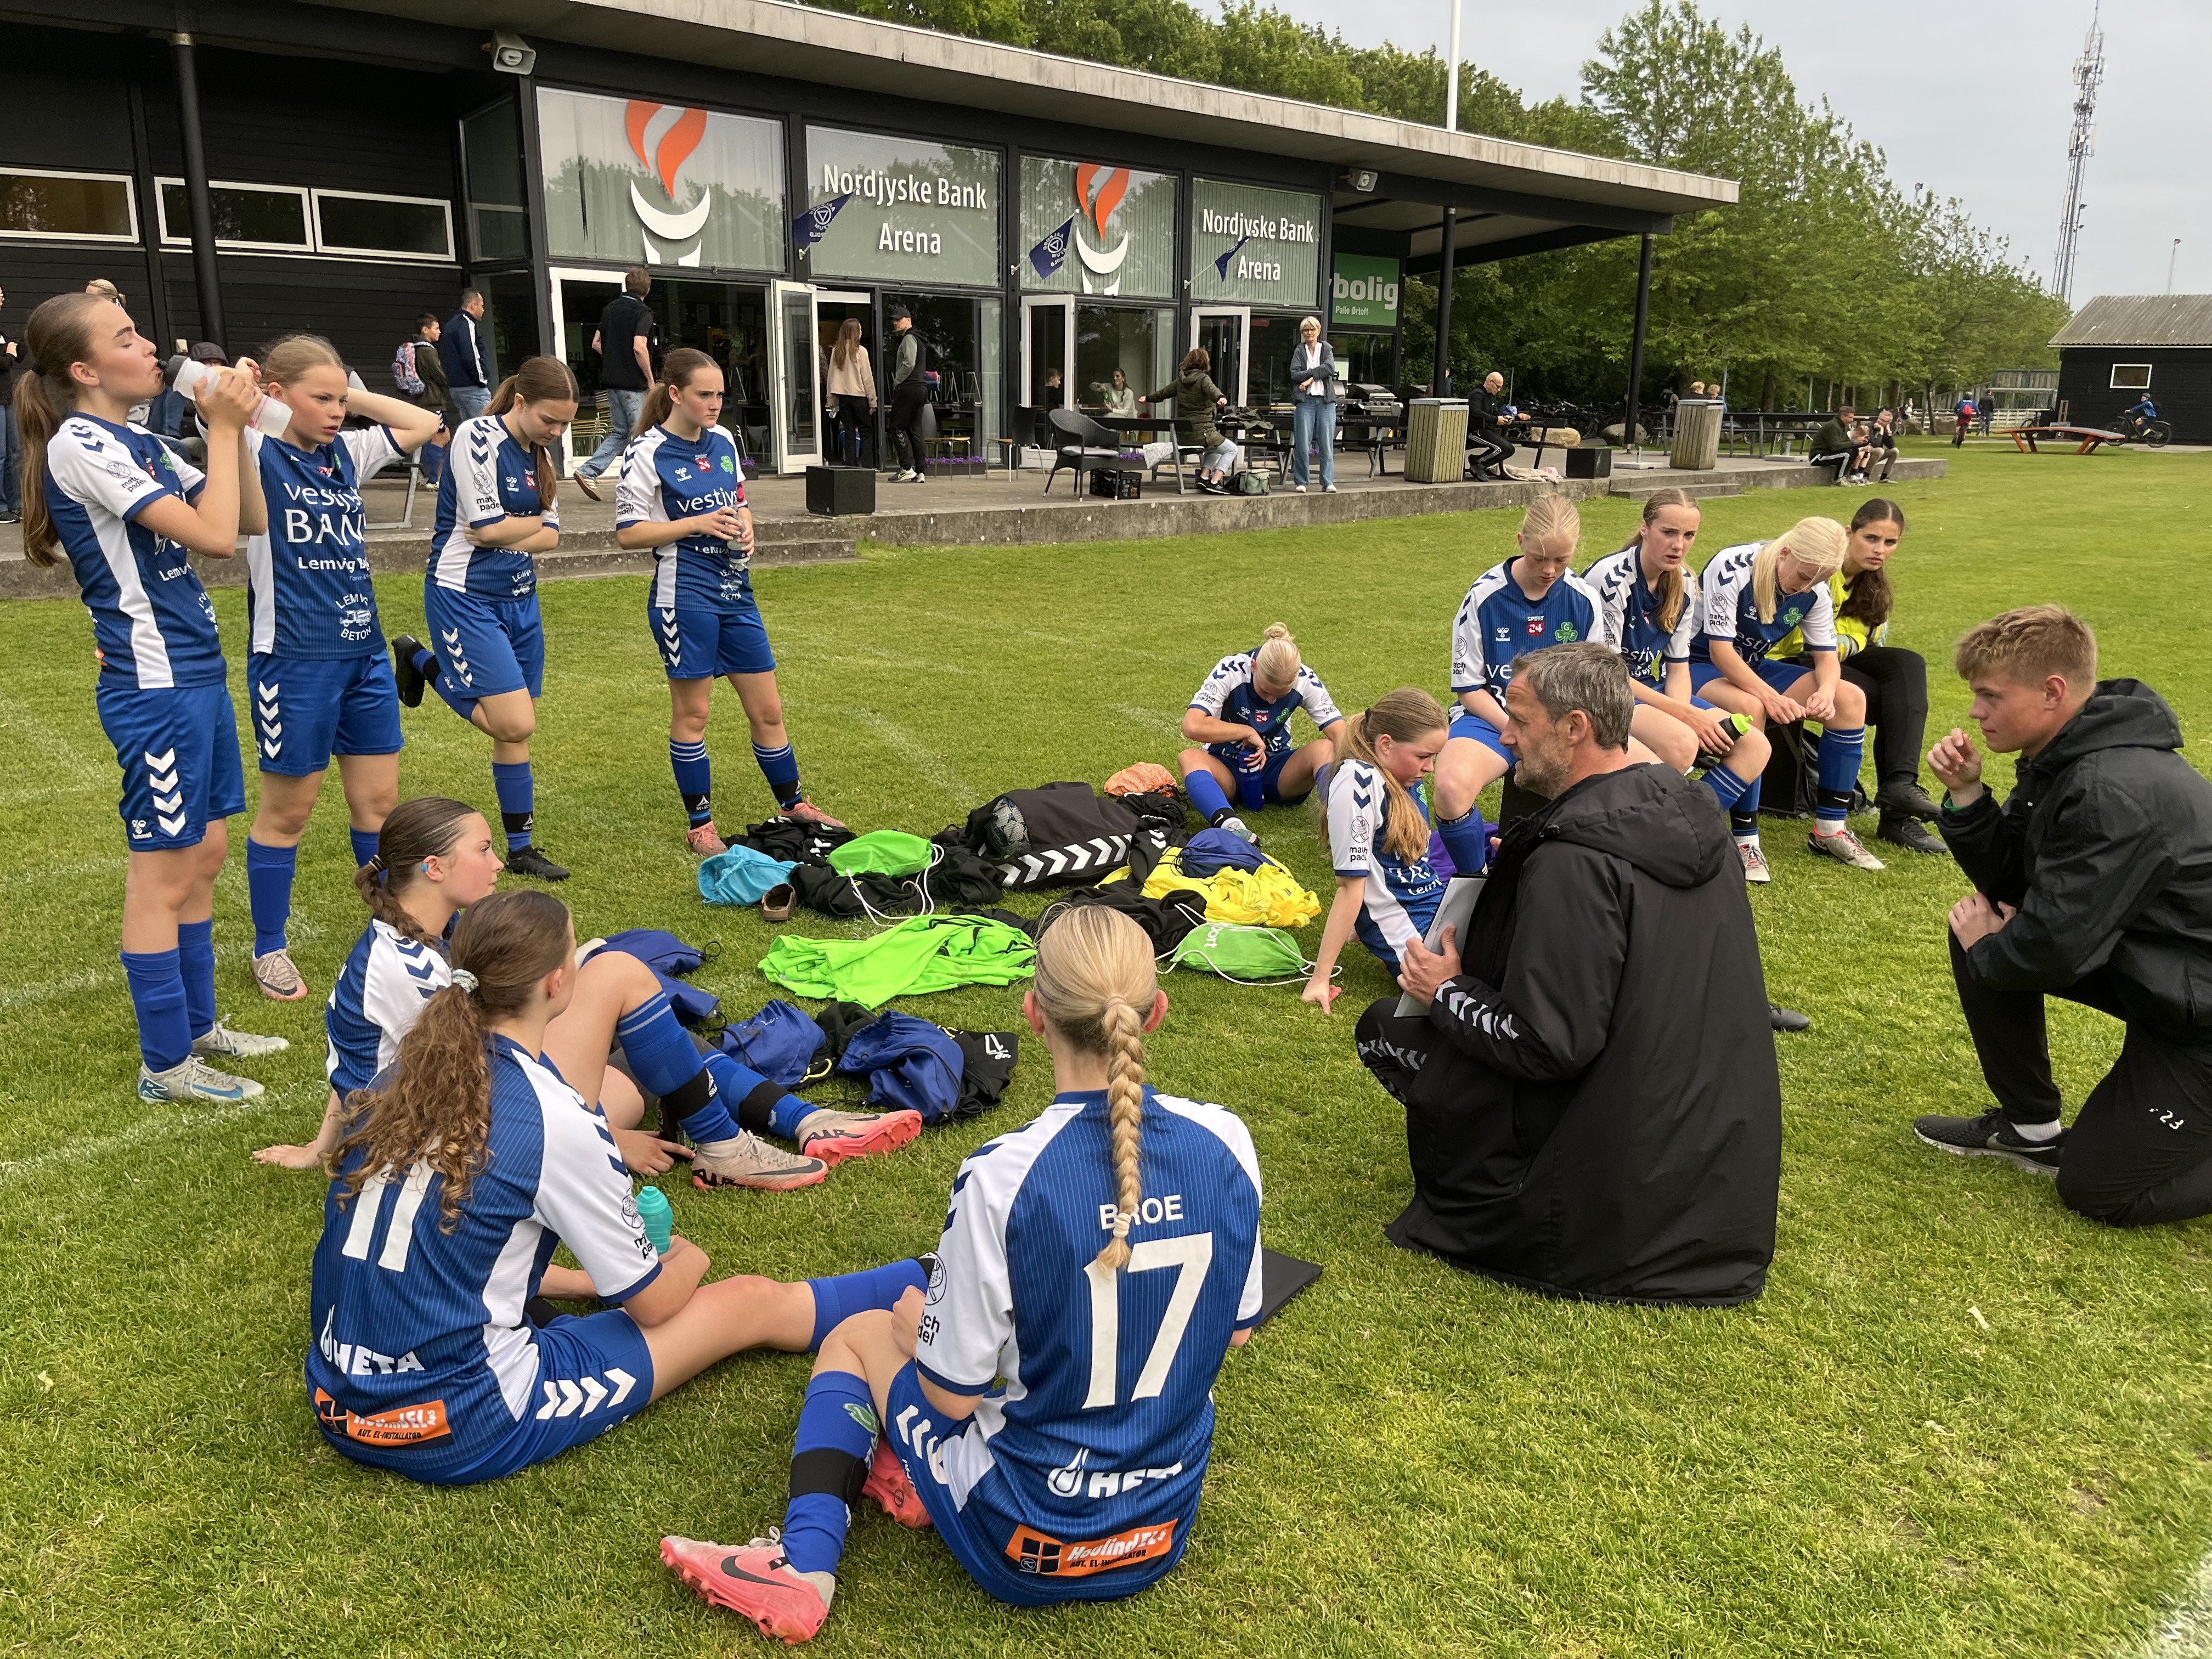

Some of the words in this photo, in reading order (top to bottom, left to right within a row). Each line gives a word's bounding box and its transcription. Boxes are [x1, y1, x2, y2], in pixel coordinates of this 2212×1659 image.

[824, 164, 932, 207] Nordjyske
[938, 178, 988, 210] Bank
[1203, 208, 1276, 242] Nordjyske
[1280, 217, 1313, 242] Bank
[878, 223, 941, 255] Arena
[1237, 255, 1280, 281] Arena
[1333, 273, 1398, 311] bolig
[1335, 305, 1350, 314] Palle
[1351, 306, 1369, 316] Ørtoft
[698, 460, 710, 470] 24
[479, 502, 501, 512] pade
[677, 487, 738, 514] vestjys
[285, 509, 366, 546] BAN
[298, 556, 356, 573] Lemvig
[341, 626, 371, 641] BETON
[1529, 623, 1543, 633] 24
[2159, 1110, 2184, 1130] 23
[806, 1129, 846, 1140] AIR
[342, 1137, 441, 1273] 11
[1081, 1231, 1212, 1409] 17
[334, 1338, 425, 1375] HETA
[357, 1428, 371, 1437] AUT.
